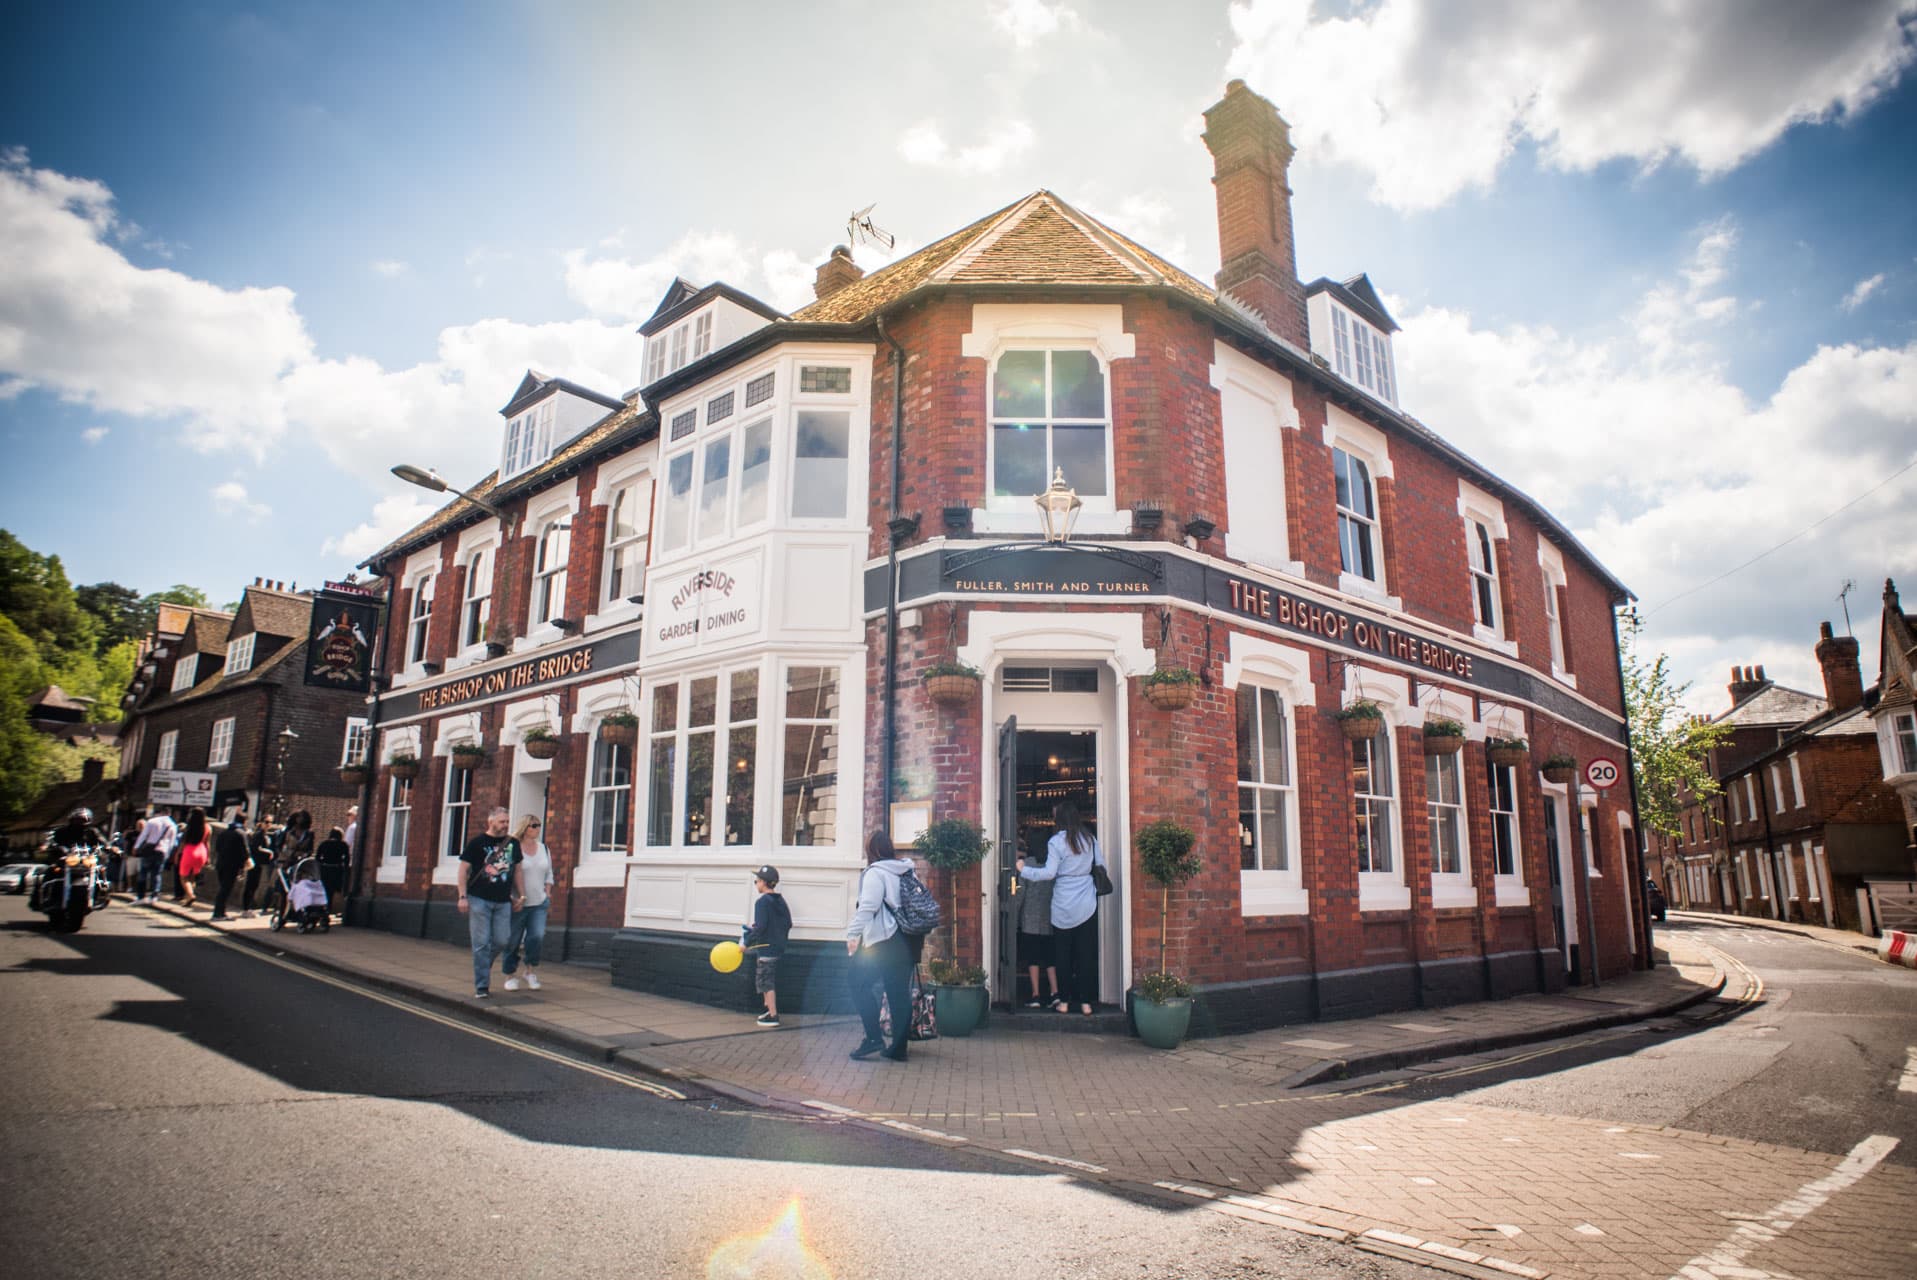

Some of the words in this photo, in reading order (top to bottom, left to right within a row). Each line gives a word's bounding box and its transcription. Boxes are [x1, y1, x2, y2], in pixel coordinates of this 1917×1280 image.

[671, 570, 736, 612] RIVERSIDE
[1014, 581, 1054, 592] SMITH
[1061, 582, 1090, 592] AND
[1097, 582, 1150, 592] TURNER
[707, 608, 745, 630] DINING
[1228, 579, 1272, 619] THE
[1277, 594, 1349, 641] BISHOP
[1354, 621, 1383, 652] ON
[1387, 630, 1418, 662] THE
[1421, 641, 1473, 679] BRIDGE
[419, 689, 438, 710] THE
[440, 675, 483, 704] BISHOP
[485, 671, 506, 694] ON
[510, 664, 535, 688] THE
[538, 648, 593, 681] BRIDGE
[1591, 766, 1616, 780] 20
